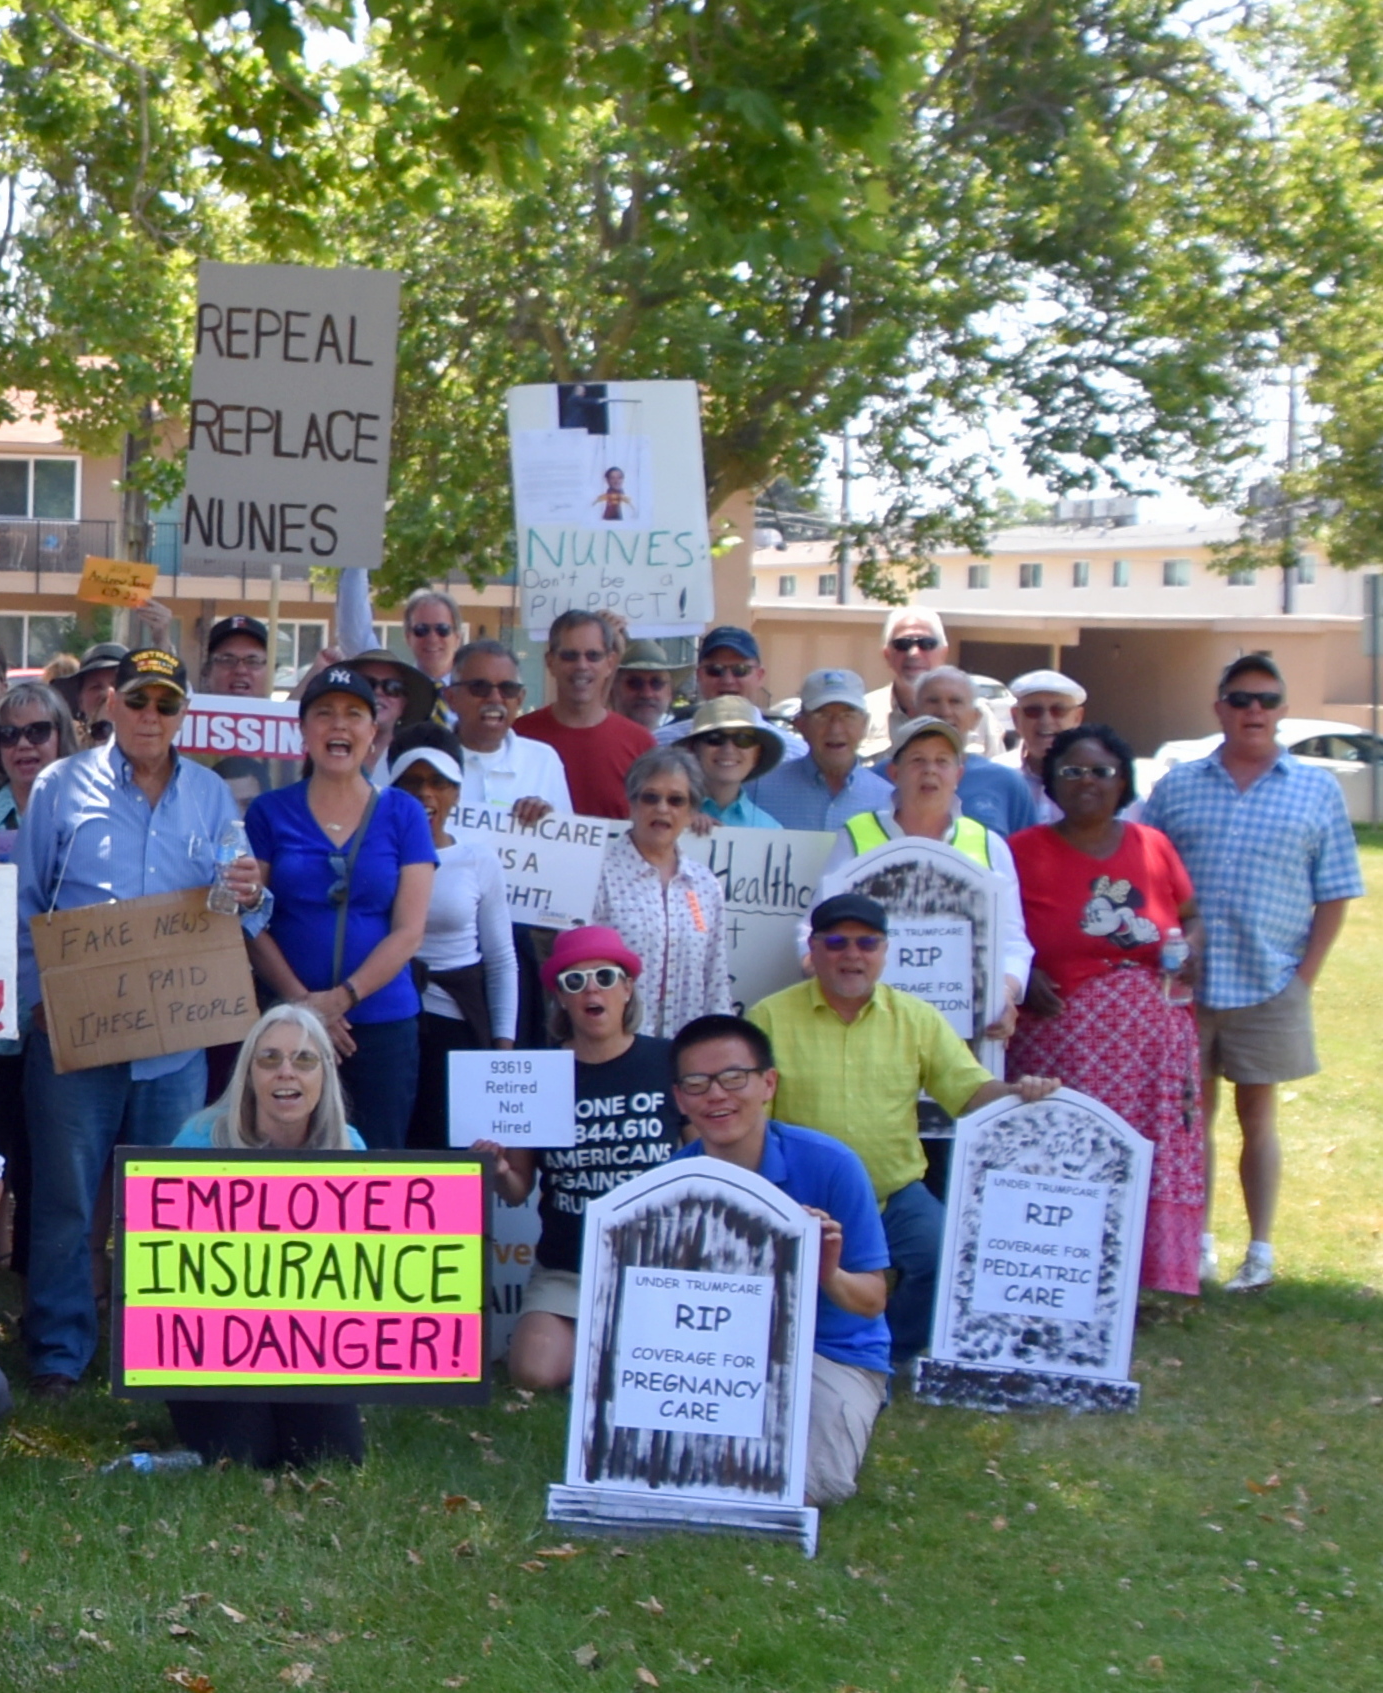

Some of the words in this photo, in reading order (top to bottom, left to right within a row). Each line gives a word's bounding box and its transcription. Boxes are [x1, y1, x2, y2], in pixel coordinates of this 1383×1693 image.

[196, 303, 374, 366] REPEAL
[189, 399, 380, 465] REPLACE
[184, 494, 338, 557] NUNES
[527, 528, 706, 568] NUNES:
[523, 568, 579, 590] Don't
[601, 568, 625, 588] be
[661, 573, 674, 586] a
[173, 714, 303, 756] MISSIN
[522, 852, 539, 873] A
[708, 839, 812, 909] Healthc
[61, 921, 133, 959] FAKE
[153, 911, 211, 939] NEWS
[905, 926, 964, 938] TRUMPCARE
[899, 946, 942, 967] RIP
[117, 973, 128, 998] I
[148, 966, 207, 993] PAID
[938, 982, 963, 992] FOR
[167, 996, 250, 1025] PEOPLE
[490, 1061, 532, 1074] 93619
[485, 1081, 537, 1094] Retired
[499, 1101, 524, 1114] Not
[575, 1096, 626, 1119] ONE
[632, 1092, 665, 1113] OF
[492, 1120, 531, 1134] Hired
[546, 1143, 673, 1169] AMERICANS
[994, 1177, 1031, 1190] UNDER
[1036, 1182, 1100, 1199] TRUMPCARE
[151, 1177, 436, 1231] EMPLOYER
[1025, 1202, 1073, 1227] RIP
[988, 1238, 1058, 1257] COVERAGE
[1064, 1246, 1091, 1259] FOR
[137, 1240, 464, 1303] INSURANCE
[982, 1258, 1092, 1285] PEDIATRIC
[635, 1276, 680, 1290] UNDER
[686, 1279, 762, 1296] TRUMPCARE
[1004, 1284, 1065, 1308] CARE
[675, 1304, 732, 1332] RIP
[156, 1313, 204, 1367] IN
[223, 1314, 462, 1371] DANGER!
[631, 1346, 716, 1368] COVERAGE
[723, 1353, 756, 1369] FOR
[621, 1370, 761, 1399] PREGNANCY
[659, 1400, 719, 1422] CARE
